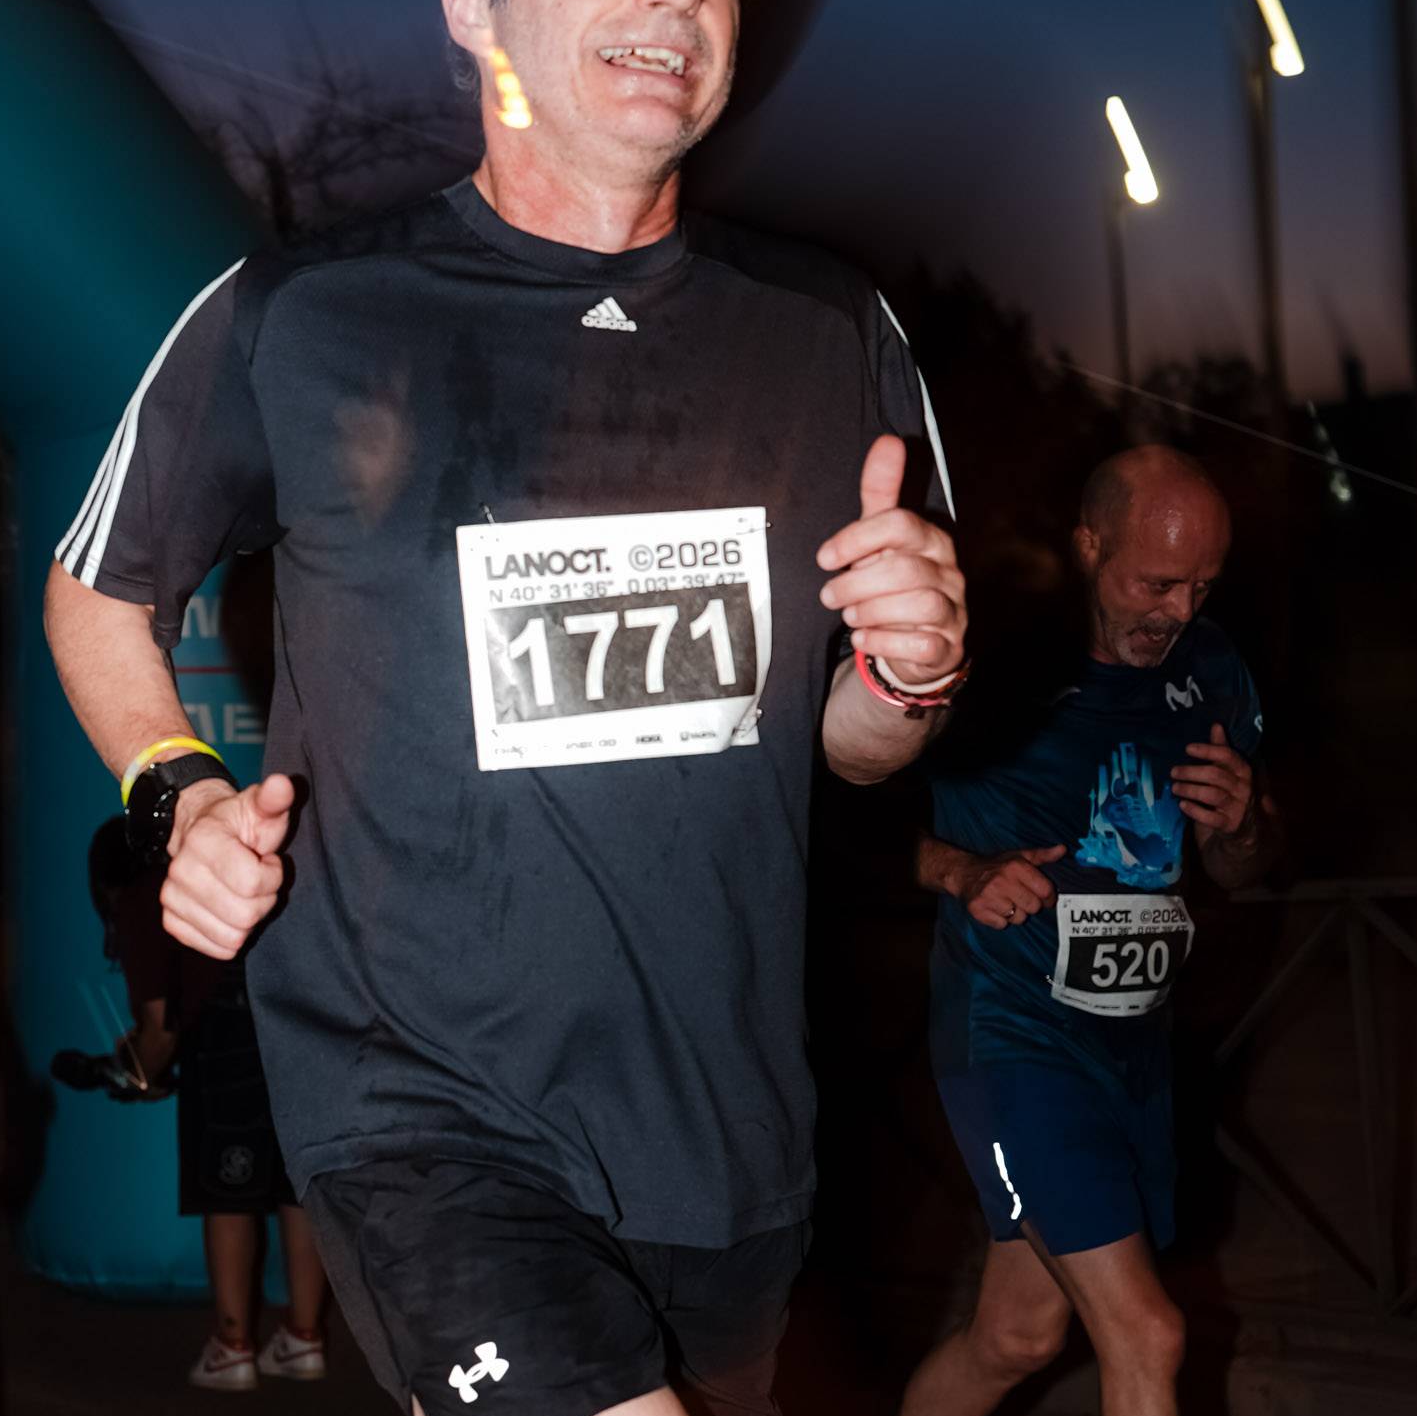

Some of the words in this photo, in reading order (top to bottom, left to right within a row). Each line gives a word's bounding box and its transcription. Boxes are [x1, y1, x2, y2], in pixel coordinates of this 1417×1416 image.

[485, 548, 611, 581] LANOCT.
[628, 540, 742, 572] ©2026
[489, 589, 503, 603] N
[510, 585, 543, 601] 40°
[509, 598, 736, 707] 1771
[1070, 909, 1133, 924] LANOCT.
[1091, 939, 1170, 988] 520
